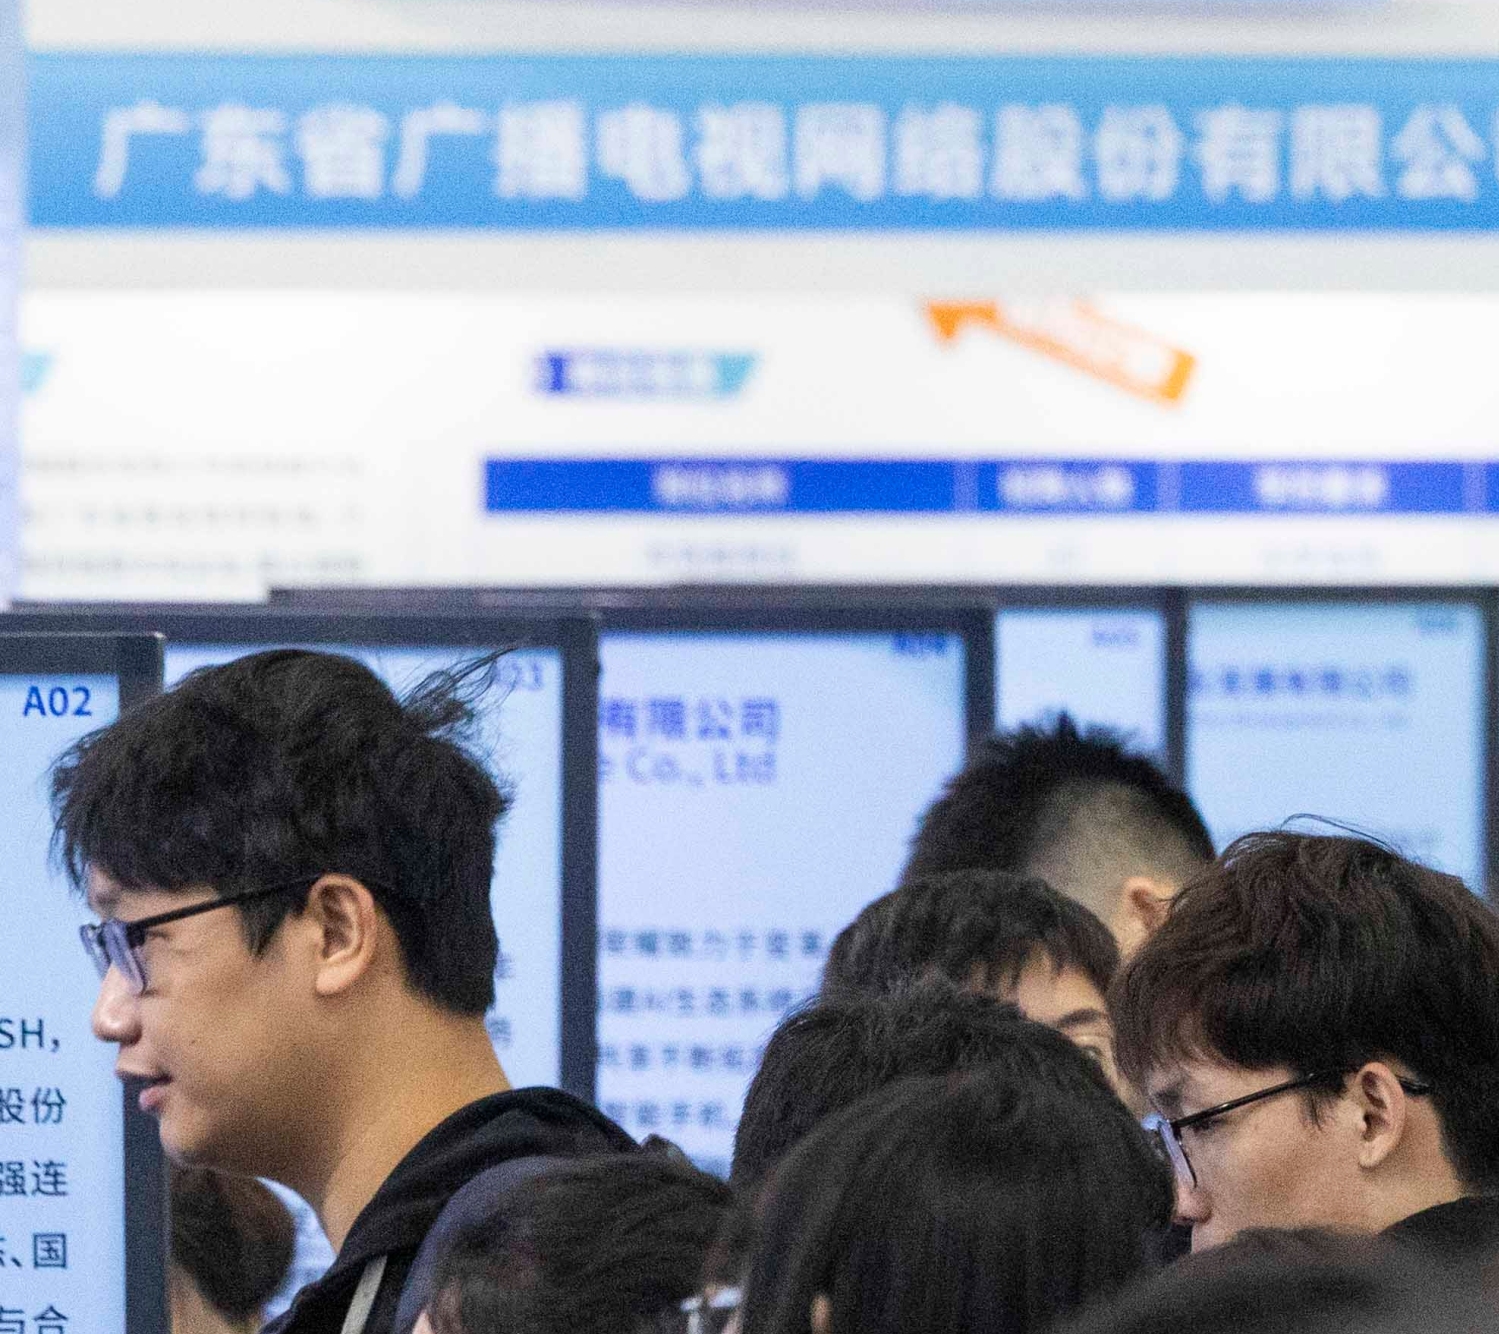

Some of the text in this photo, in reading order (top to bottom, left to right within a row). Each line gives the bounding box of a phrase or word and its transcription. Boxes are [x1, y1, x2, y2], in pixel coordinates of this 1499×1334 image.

[23, 685, 92, 717] A02
[601, 697, 780, 743] 有限公司
[0, 1233, 67, 1268] 、国
